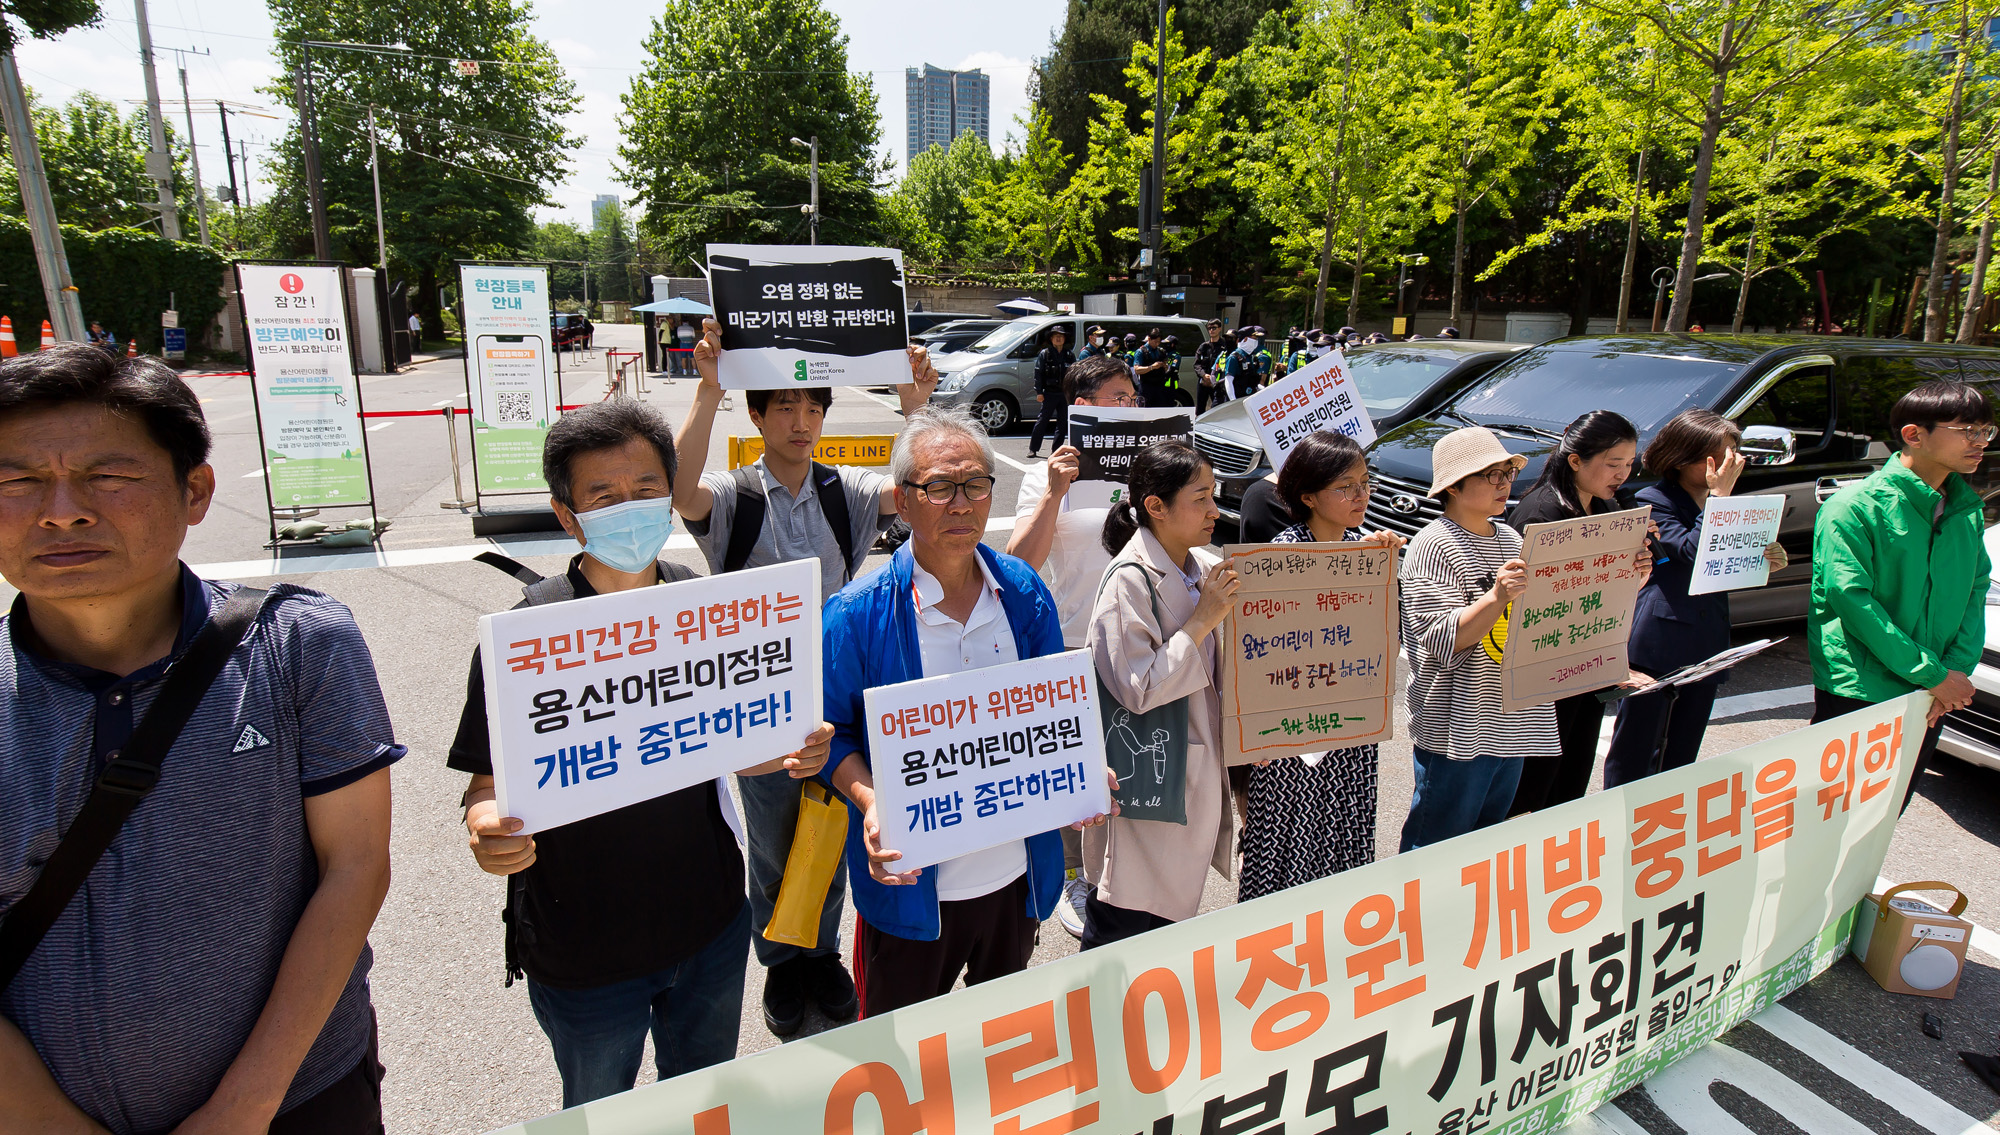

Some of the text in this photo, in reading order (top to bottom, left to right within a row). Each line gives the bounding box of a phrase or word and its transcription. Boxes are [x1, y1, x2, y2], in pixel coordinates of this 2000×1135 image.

[474, 278, 536, 294] 현장등록
[762, 282, 864, 301] 오염 정화 없는
[491, 296, 522, 310] 안내
[254, 317, 301, 325] 용산어린이정원
[317, 317, 331, 325] 입장
[728, 308, 896, 329] 미군기지 반환 규탄한다!
[255, 327, 341, 342] 방문예약이
[258, 344, 343, 354] 반드시 필요합니다!
[275, 376, 335, 384] 방문예약 바로가기
[280, 368, 329, 376] 용산어린이정원
[1258, 365, 1345, 427] 토양오염 심각한
[1274, 391, 1353, 451] 용산어린이정원
[853, 445, 887, 458] LINE
[1082, 434, 1137, 449] 발암물질로
[1099, 454, 1131, 468] 어린이
[1609, 516, 1635, 532] 야구장
[1709, 508, 1778, 527] 어린이가 위험하다!
[1709, 530, 1770, 552] 용산어린이정원
[1325, 554, 1353, 577] 정권
[1356, 549, 1389, 577] 홍보?
[1535, 565, 1560, 578] 어린이
[1703, 554, 1765, 577] 개방 중단하라!
[1594, 571, 1610, 584] 하면
[1242, 590, 1374, 620] 어린이가 위험하다!
[1578, 590, 1603, 616] 정원
[506, 591, 804, 676] 국민건강 위협하는
[1320, 623, 1353, 647] 정원
[1531, 609, 1627, 652] 개방 중단하라!
[528, 636, 794, 735] 용산어린이정원
[1265, 665, 1303, 690] 개방
[880, 675, 1088, 740] 어린이가 위험하다!
[533, 689, 793, 791] 개방 중단하라!
[900, 715, 1084, 787] 용산어린이정원
[905, 761, 1087, 833] 개방 중단하라!
[1130, 797, 1141, 807] is
[1144, 795, 1162, 807] all
[1460, 819, 1606, 971] 개방
[1630, 757, 1798, 900] 중단을
[1817, 715, 1904, 822] 위한
[1772, 934, 1823, 982] 녹색연합
[1427, 891, 1705, 1103] 기자회견
[1506, 1014, 1639, 1112] 어린이정원
[1647, 973, 1714, 1041] 출입구
